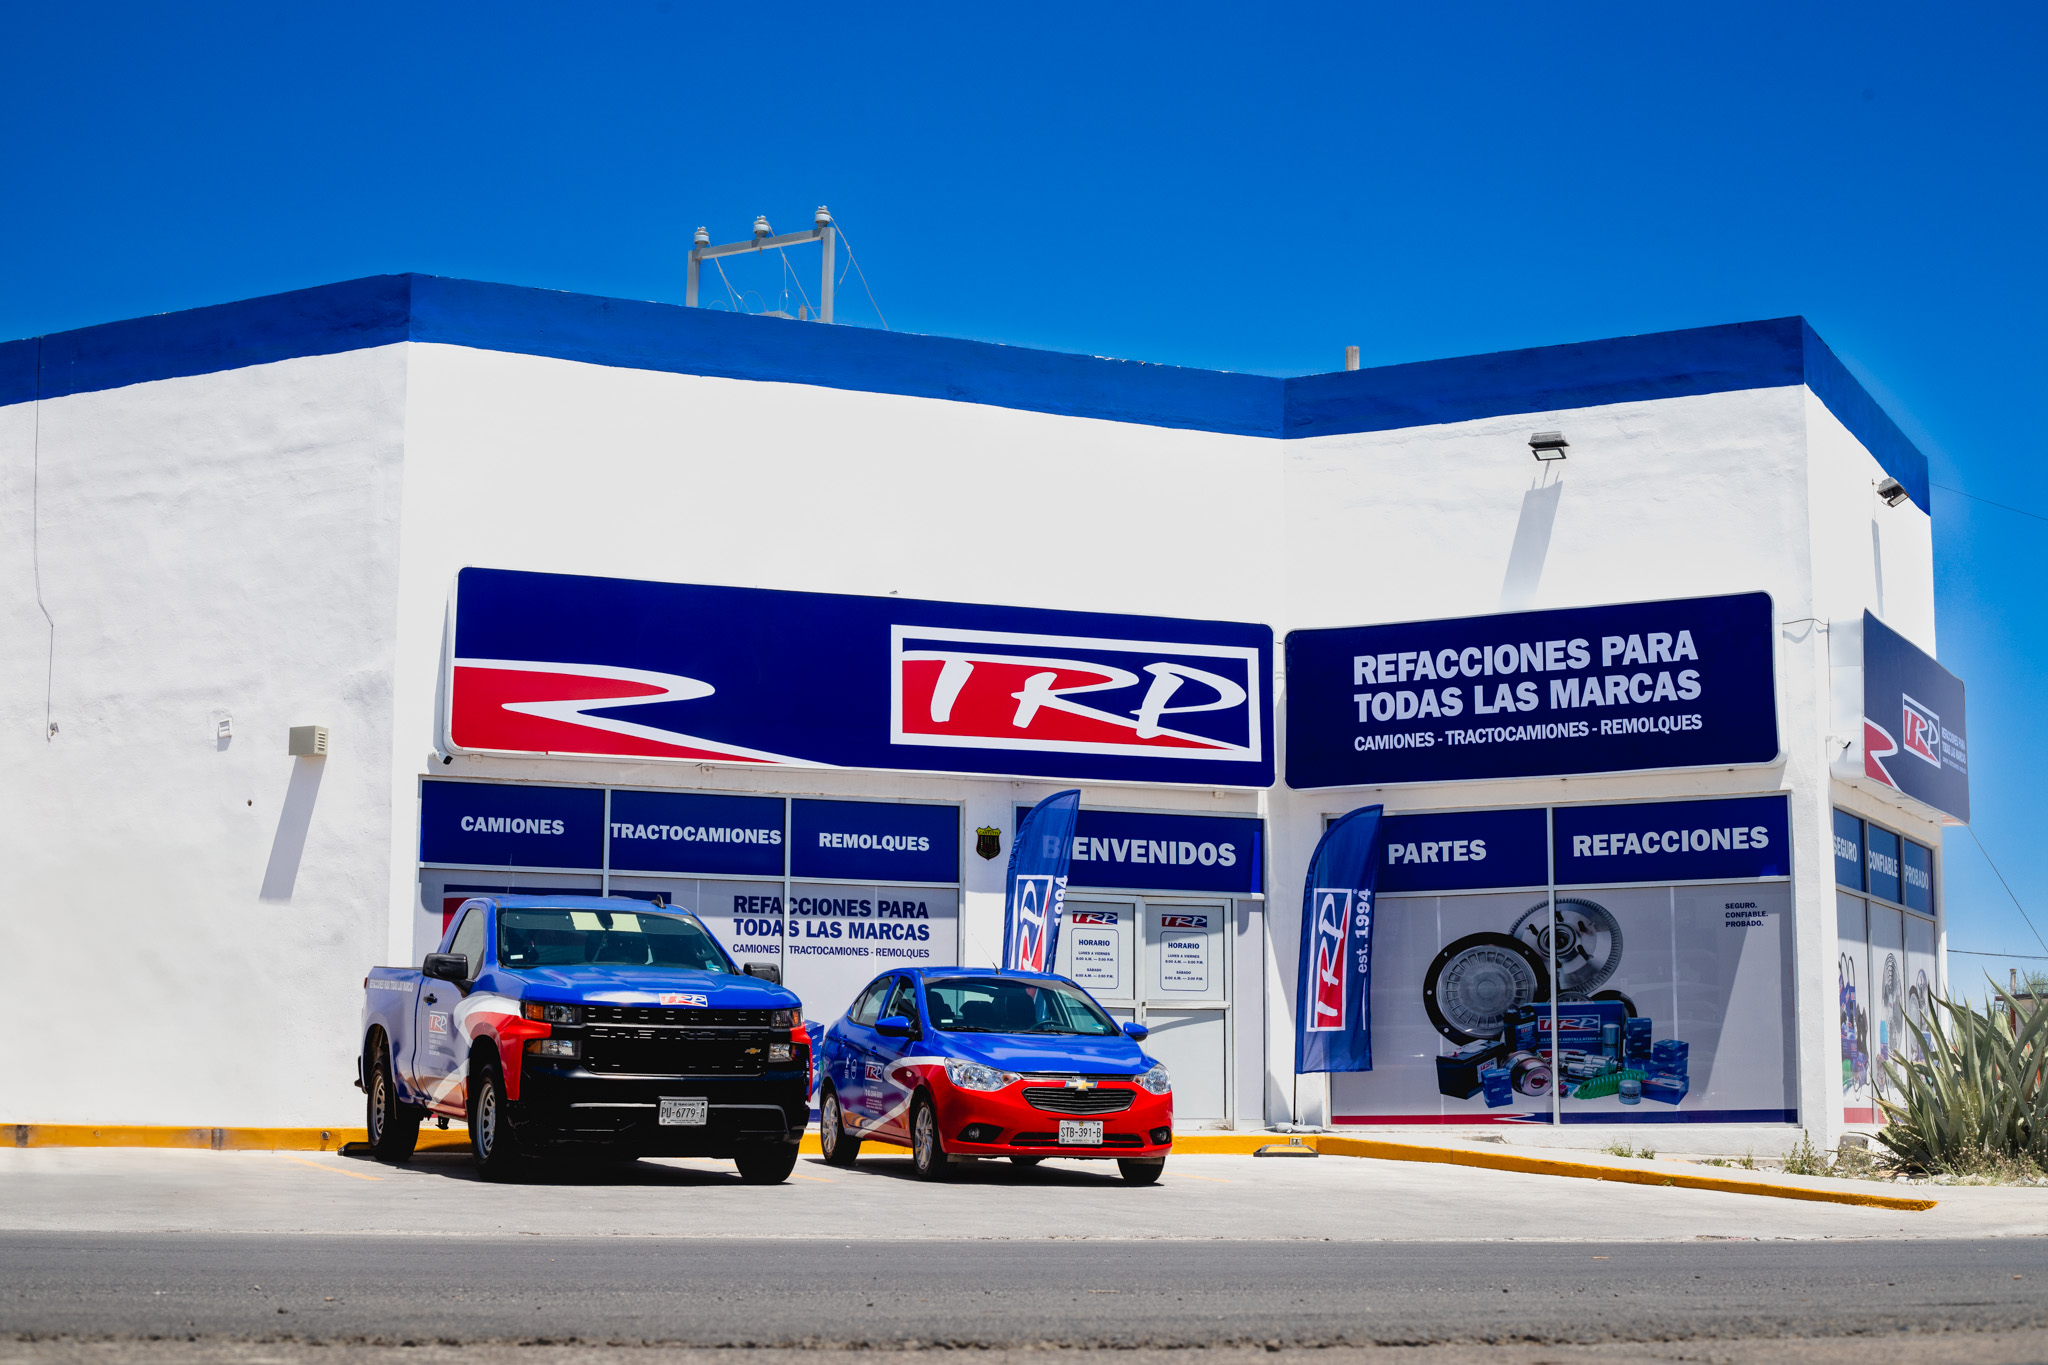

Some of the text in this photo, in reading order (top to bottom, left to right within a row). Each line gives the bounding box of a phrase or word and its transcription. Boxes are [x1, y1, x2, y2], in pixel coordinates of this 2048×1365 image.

[1353, 630, 1698, 685] REFACCIONES PARA
[902, 650, 1249, 751] TRP
[1354, 669, 1702, 723] TODAS LAS MARCAS
[1354, 731, 1435, 751] CAMIONES
[1445, 721, 1590, 746] TRACTOCAMIONES
[1600, 714, 1703, 736] REMOLQUES
[1904, 704, 1940, 763] TRP
[461, 815, 564, 835] CAMIONES
[611, 822, 782, 845] TRACTOCAMIONES
[819, 832, 930, 852] REMOLQUES
[1388, 840, 1487, 865] PARTES
[1573, 826, 1769, 858] REFACCIONES
[1869, 850, 1898, 878] CONFIABLE
[1905, 865, 1929, 890] PROBADO
[733, 895, 929, 919] REFACCIONES PARA
[1054, 875, 1068, 926] 1994
[1073, 912, 1118, 925] TRP
[1162, 915, 1207, 928] TRP
[1725, 910, 1769, 918] CONFIABLE.
[733, 918, 930, 941] TODAS LAS MARCAS
[1355, 888, 1372, 974] est. 1994
[733, 944, 780, 954] CAMIONES
[789, 945, 869, 956] TRACTOCAMIONES
[875, 948, 930, 958] REMOLQUES
[1315, 892, 1349, 1028] TRP
[661, 993, 707, 1007] TRP
[660, 1106, 705, 1118] PU-6779-A
[1061, 1127, 1102, 1138] STB-391-B
